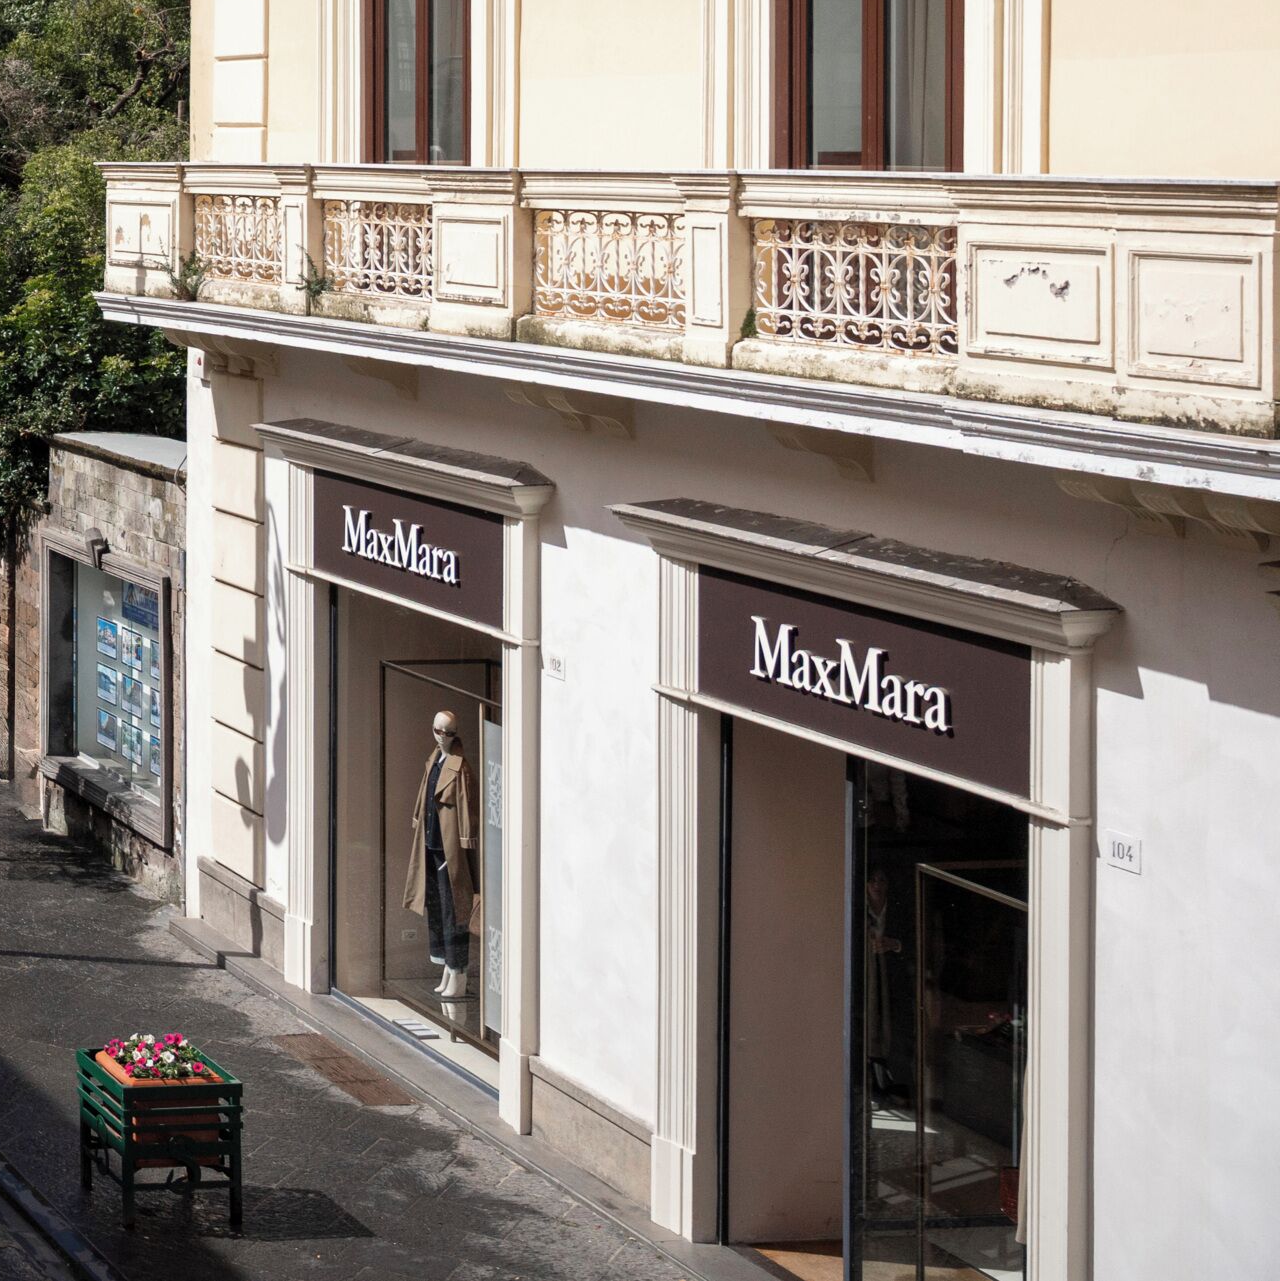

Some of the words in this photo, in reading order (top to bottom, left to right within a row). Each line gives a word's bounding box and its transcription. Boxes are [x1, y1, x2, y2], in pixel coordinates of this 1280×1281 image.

[342, 505, 460, 584] MaxMara
[749, 615, 951, 732] MaxMara
[1112, 840, 1134, 862] 104
